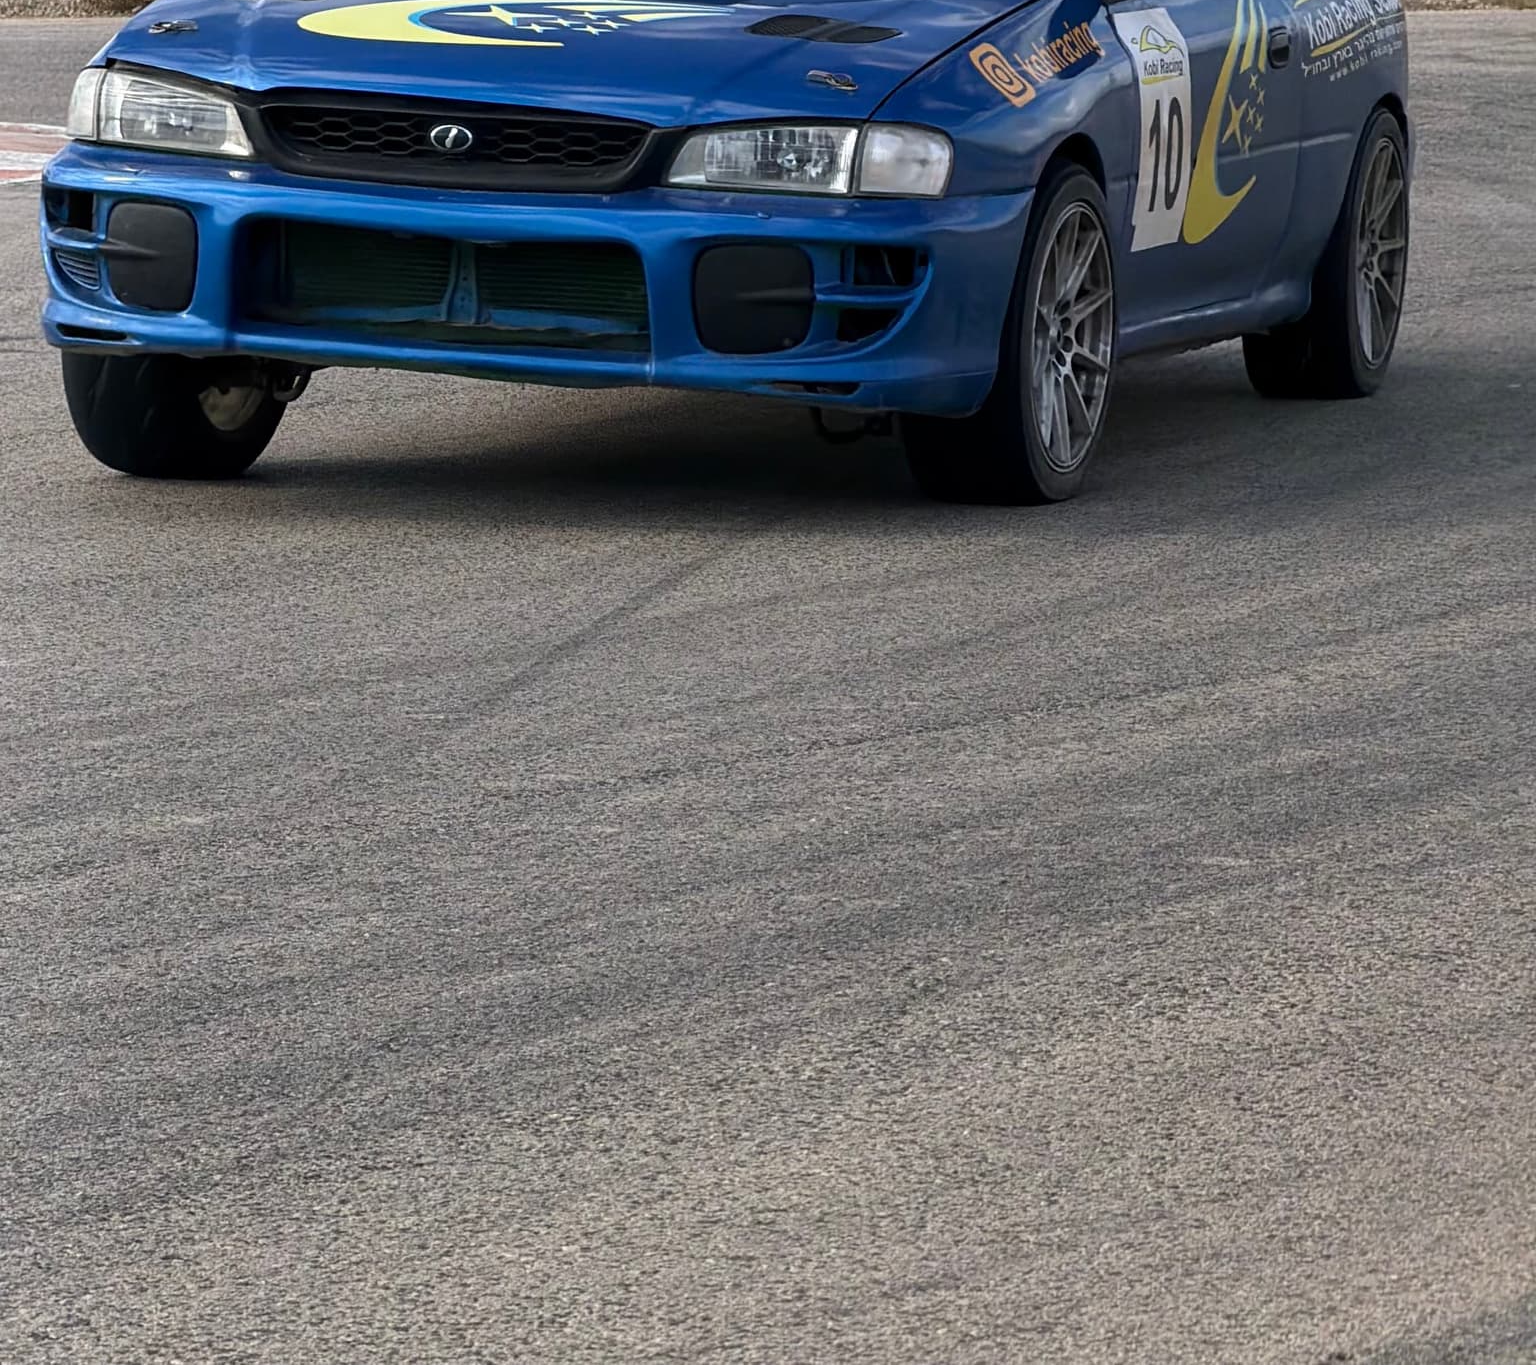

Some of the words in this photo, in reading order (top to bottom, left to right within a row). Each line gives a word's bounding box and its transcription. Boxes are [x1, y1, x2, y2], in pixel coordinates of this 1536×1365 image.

[1013, 21, 1105, 83] kobiracing
[1304, 7, 1337, 49] Kobi
[1144, 59, 1159, 76] Kobi
[1160, 58, 1184, 76] Racing
[1148, 96, 1184, 212] 10
